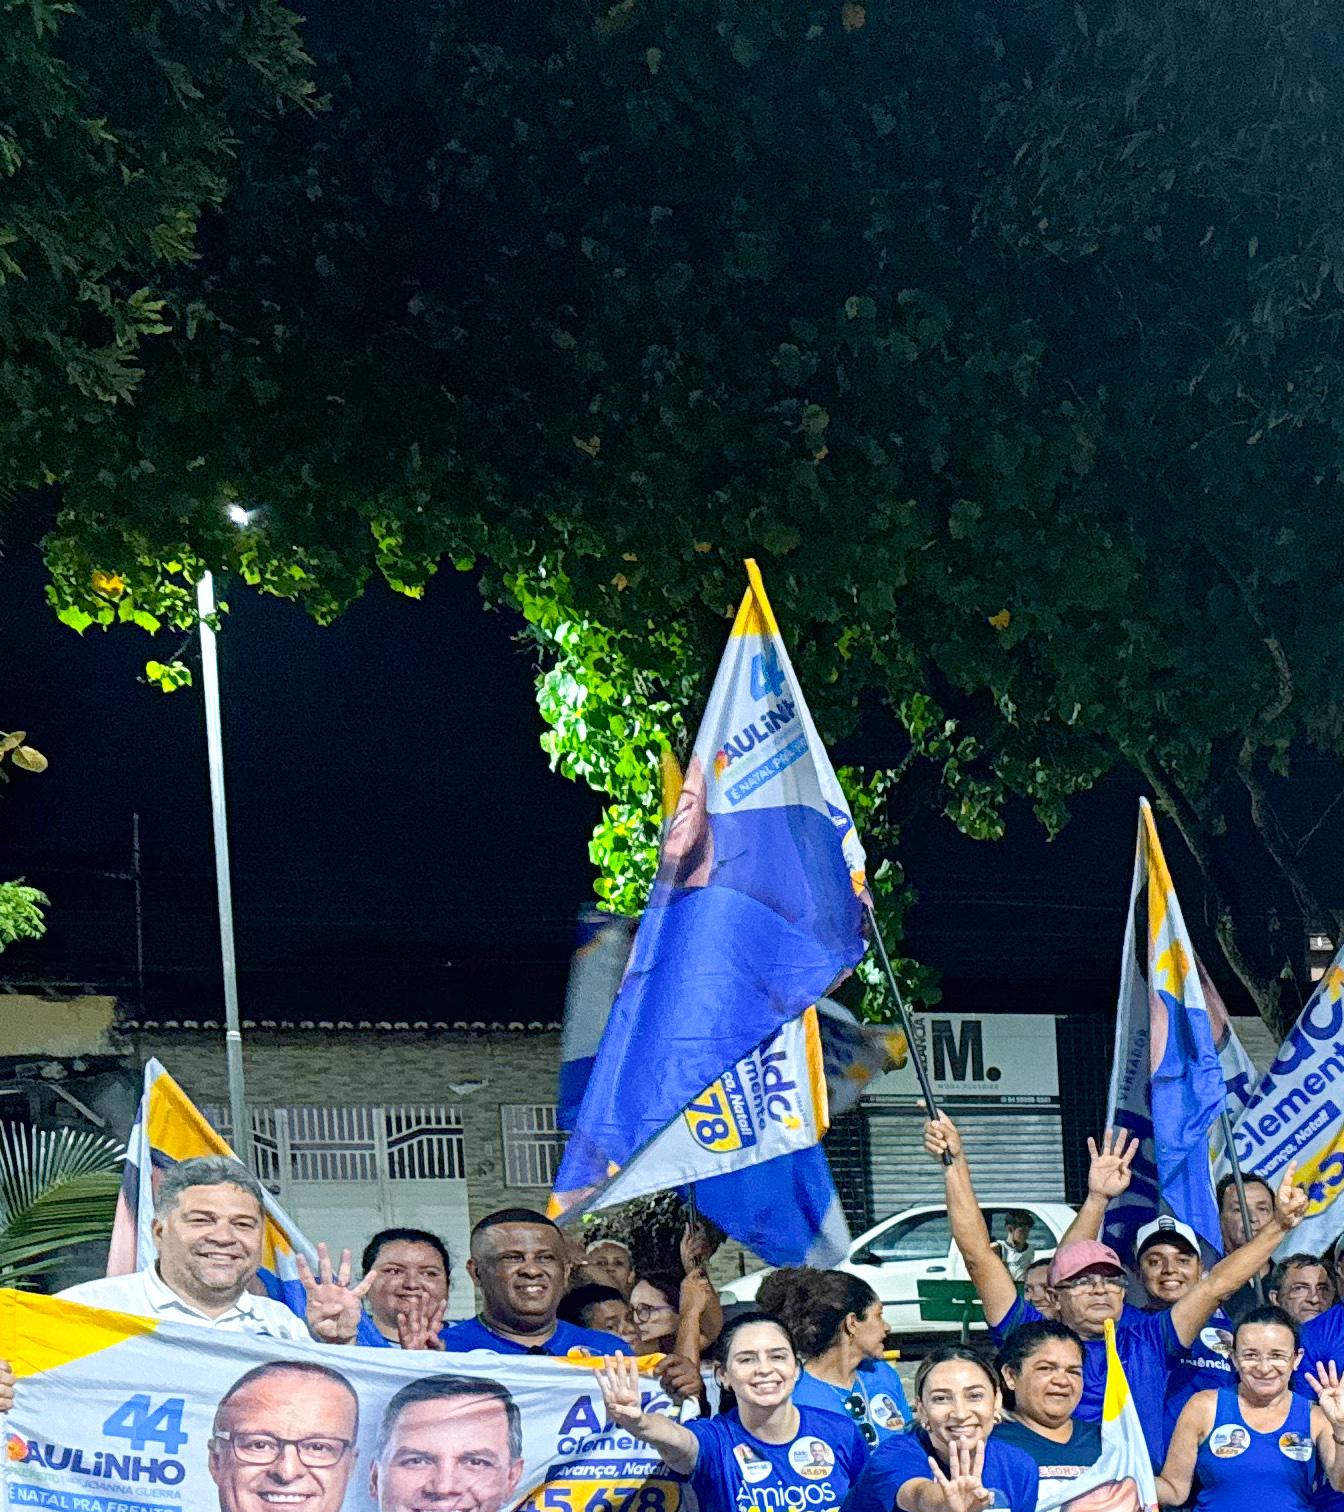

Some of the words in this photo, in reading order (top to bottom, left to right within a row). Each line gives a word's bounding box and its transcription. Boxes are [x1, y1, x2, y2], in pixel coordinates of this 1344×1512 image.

[102, 1393, 189, 1455] 44
[17, 1488, 71, 1510] NATAL
[72, 1497, 103, 1512] PRA
[735, 1480, 837, 1512] Amigos
